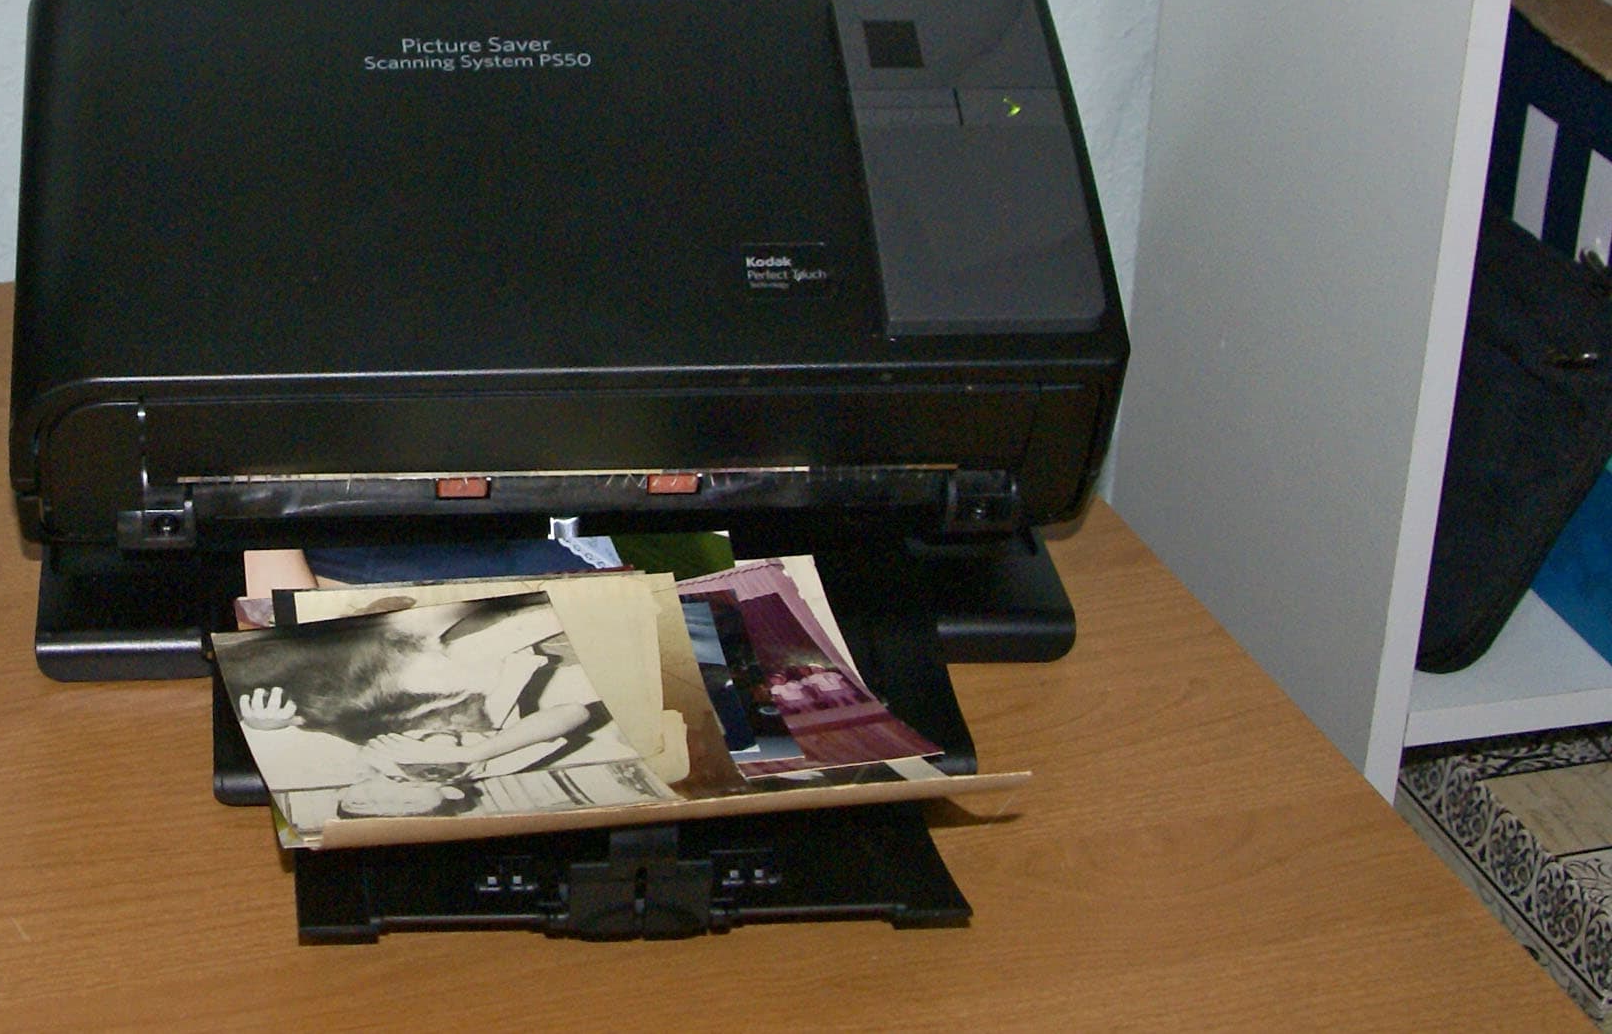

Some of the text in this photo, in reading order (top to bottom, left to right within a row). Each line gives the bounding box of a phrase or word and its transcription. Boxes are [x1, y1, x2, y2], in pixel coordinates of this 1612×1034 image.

[401, 36, 552, 54] Picture Saver
[364, 55, 456, 71] Scanning
[460, 54, 534, 71] System
[746, 256, 792, 267] Kodak
[792, 269, 827, 281] Touch
